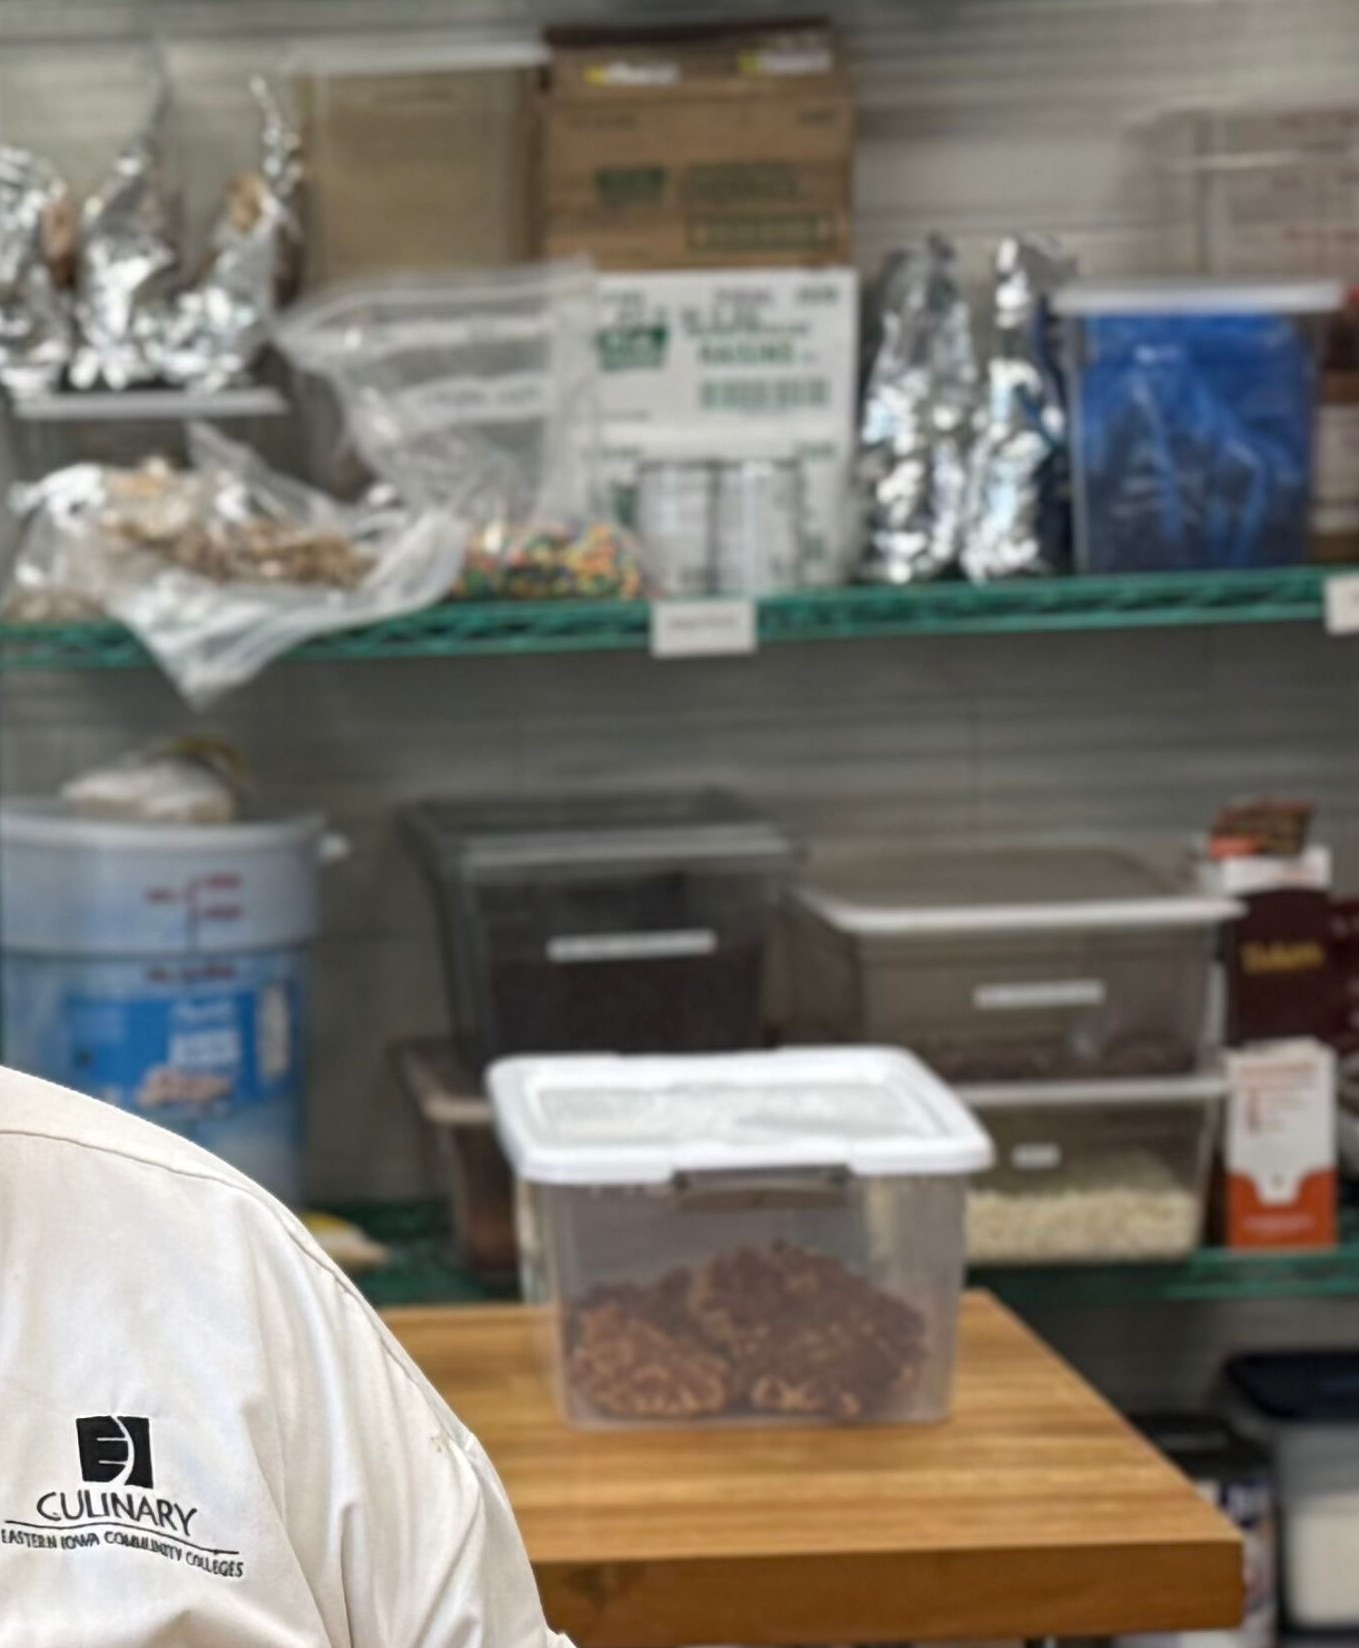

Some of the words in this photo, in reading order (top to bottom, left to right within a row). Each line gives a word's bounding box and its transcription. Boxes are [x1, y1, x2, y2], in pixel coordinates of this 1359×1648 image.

[36, 1489, 198, 1537] CULINARY
[1, 1529, 58, 1549] EASTERN
[61, 1532, 100, 1550] IOWA
[105, 1531, 182, 1561] COMMUNITY
[185, 1551, 244, 1578] COLLEGES
